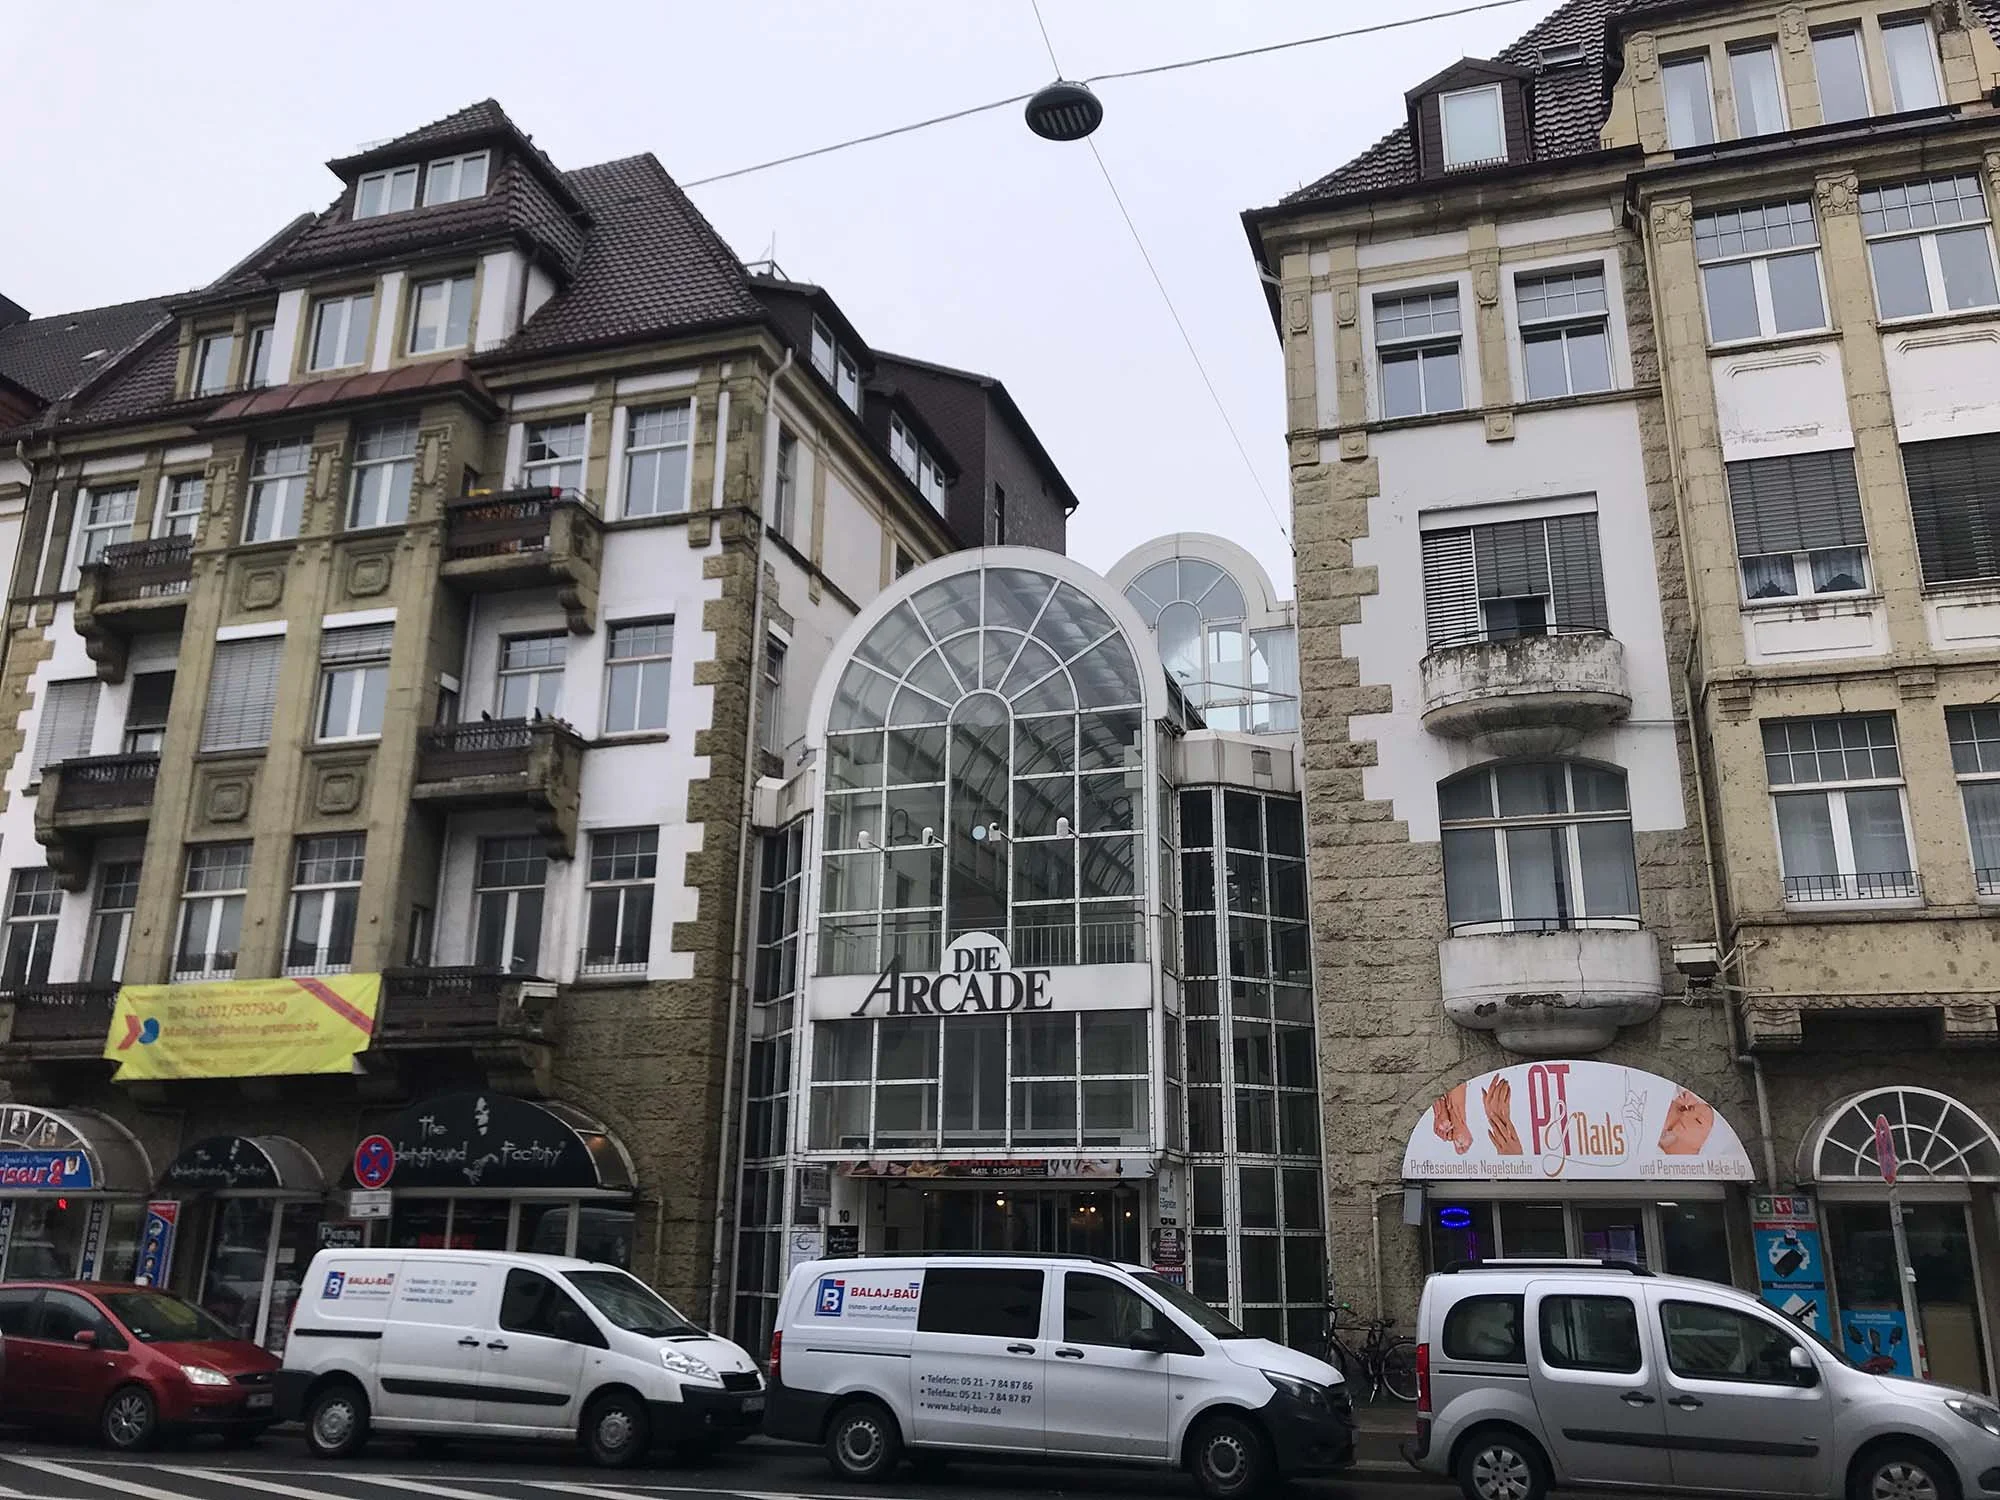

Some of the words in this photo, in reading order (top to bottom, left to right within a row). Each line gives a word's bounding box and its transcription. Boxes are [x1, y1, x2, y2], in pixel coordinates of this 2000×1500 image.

[953, 947, 1001, 973] DIE
[851, 953, 1053, 1017] ARCADE
[1528, 1064, 1570, 1155] PT
[418, 1115, 449, 1137] The
[993, 1167, 1021, 1176] DESIGN
[1410, 1160, 1478, 1175] Professionelles
[1480, 1160, 1533, 1177] Nagelstudio
[1640, 1160, 1655, 1175] und
[1657, 1160, 1705, 1175] Permanent
[1707, 1160, 1746, 1178] Make-Up
[838, 1210, 850, 1223] 10
[851, 1287, 919, 1299] BALAJ-BAU
[928, 1374, 959, 1385] Telefon:
[961, 1377, 971, 1386] 05
[973, 1378, 983, 1387] 21
[991, 1379, 996, 1387] 7
[998, 1380, 1008, 1388] 84
[1010, 1381, 1020, 1389] 87
[1022, 1382, 1033, 1390] 86
[927, 1388, 957, 1398] Telefax:
[959, 1390, 970, 1399] 05
[971, 1391, 982, 1400] 21
[989, 1392, 995, 1401] 7
[996, 1393, 1007, 1402] 84
[1008, 1394, 1019, 1402] 87
[1020, 1395, 1032, 1403] 87
[927, 1402, 1002, 1415] www.balaj-bau.de
